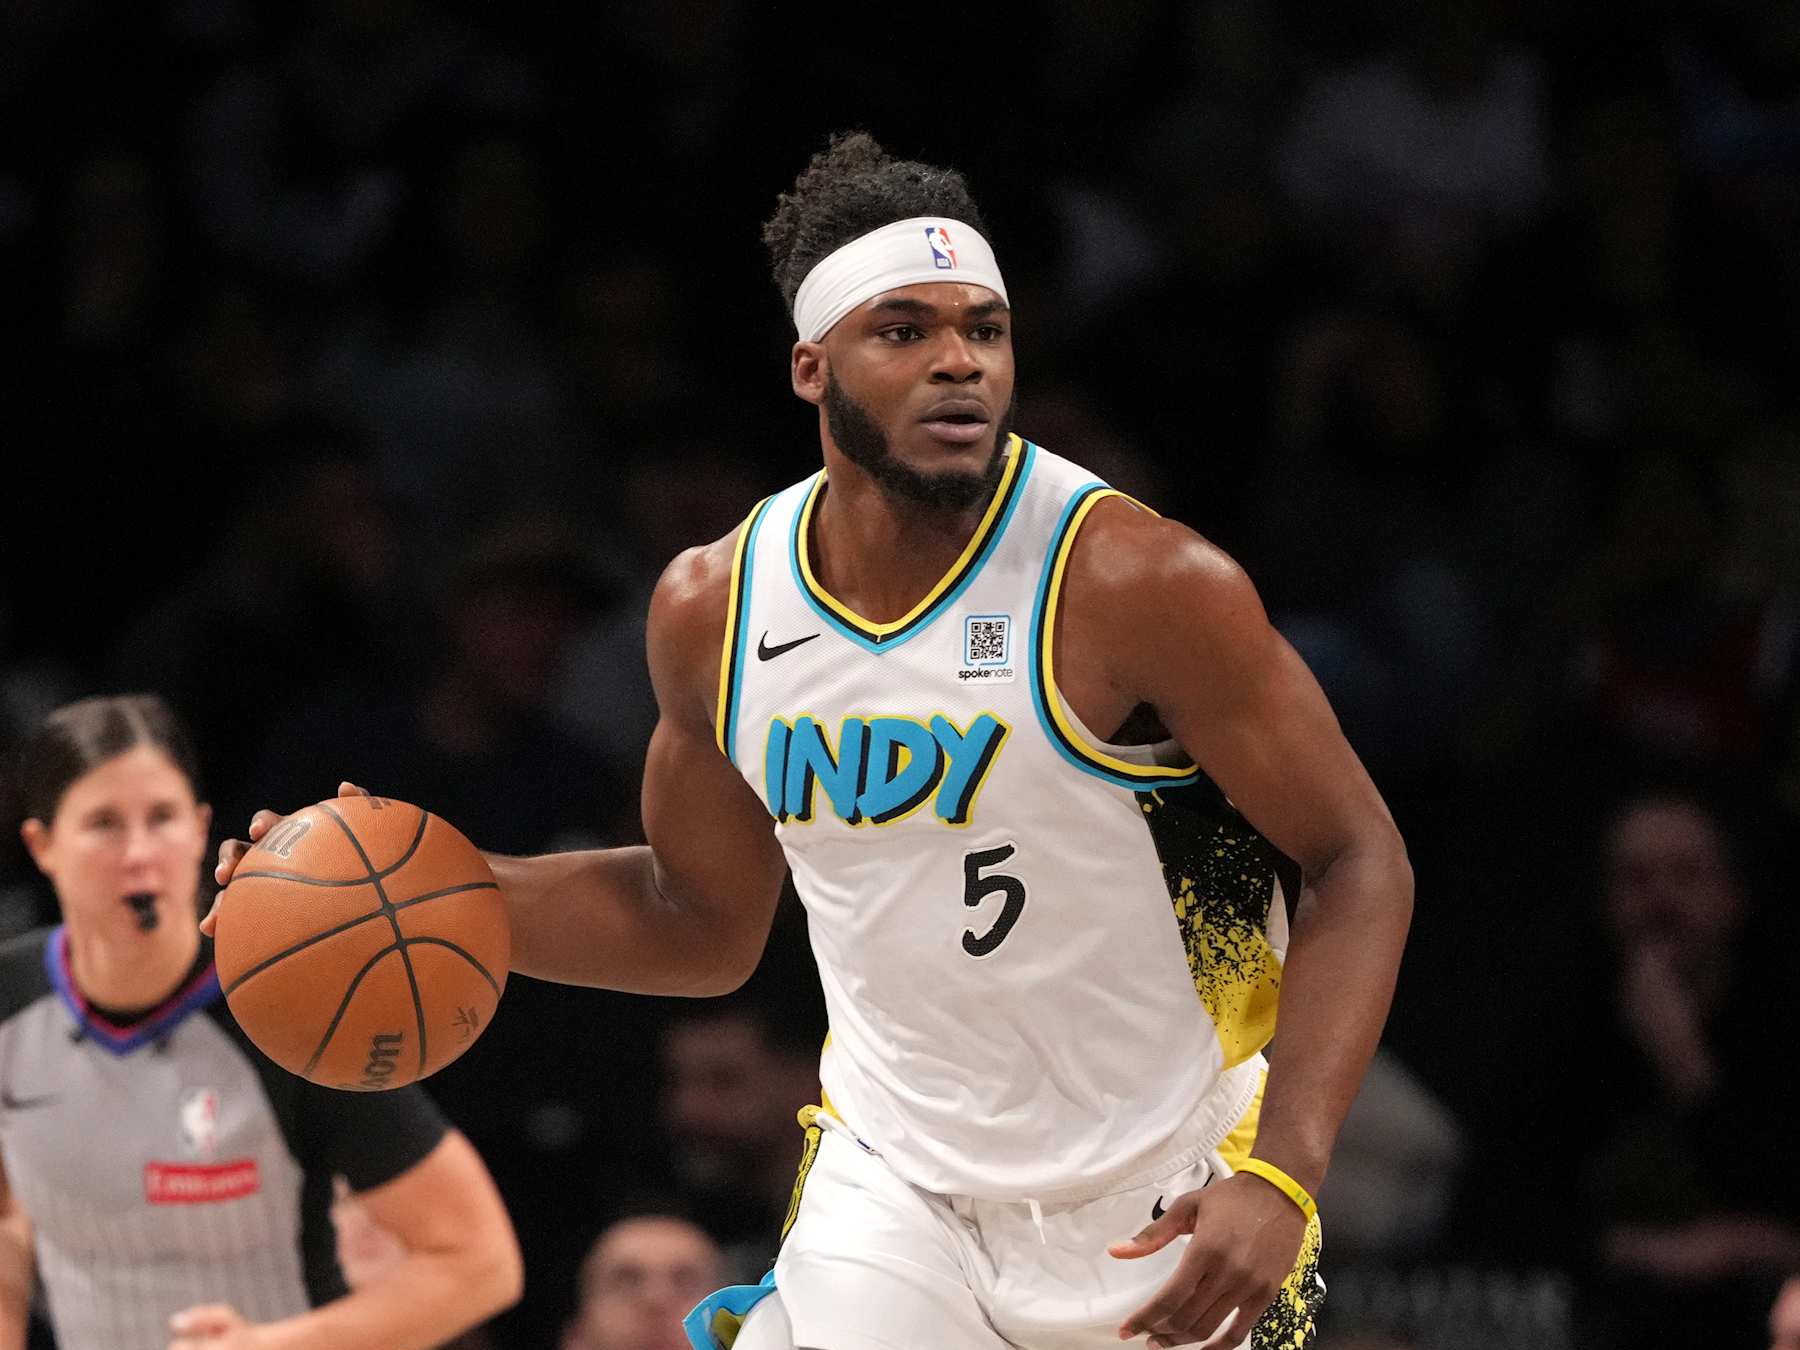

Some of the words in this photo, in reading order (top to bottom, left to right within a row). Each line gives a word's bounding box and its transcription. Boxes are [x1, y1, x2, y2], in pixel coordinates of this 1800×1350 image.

[958, 667, 1013, 681] spokenote
[764, 712, 1013, 828] INDY
[961, 843, 1027, 958] 5
